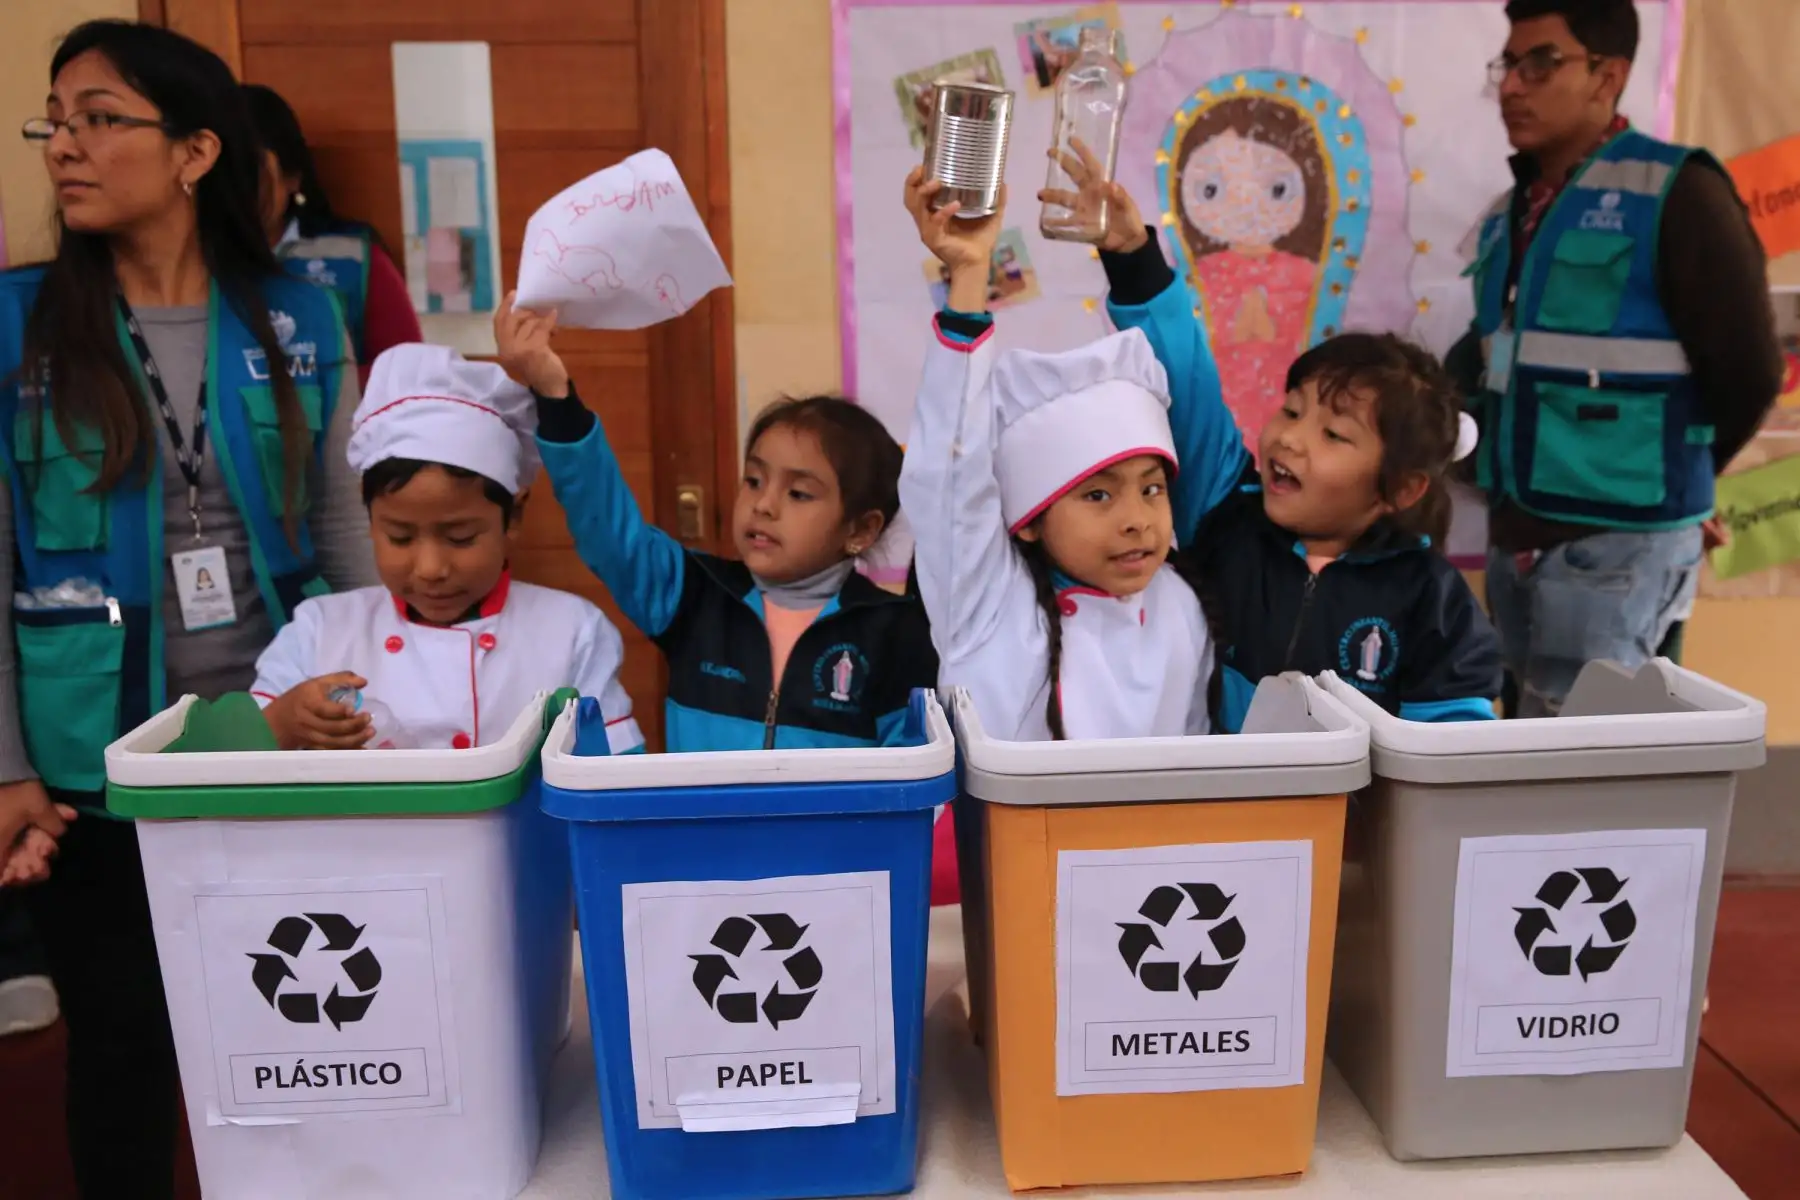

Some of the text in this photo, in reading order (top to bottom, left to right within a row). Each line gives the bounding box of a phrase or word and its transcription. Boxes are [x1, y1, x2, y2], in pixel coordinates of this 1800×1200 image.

[1517, 1013, 1619, 1038] VIDRIO
[1113, 1030, 1249, 1056] METALES
[255, 1059, 401, 1089] PLÁSTICO
[718, 1062, 812, 1088] PAPEL
